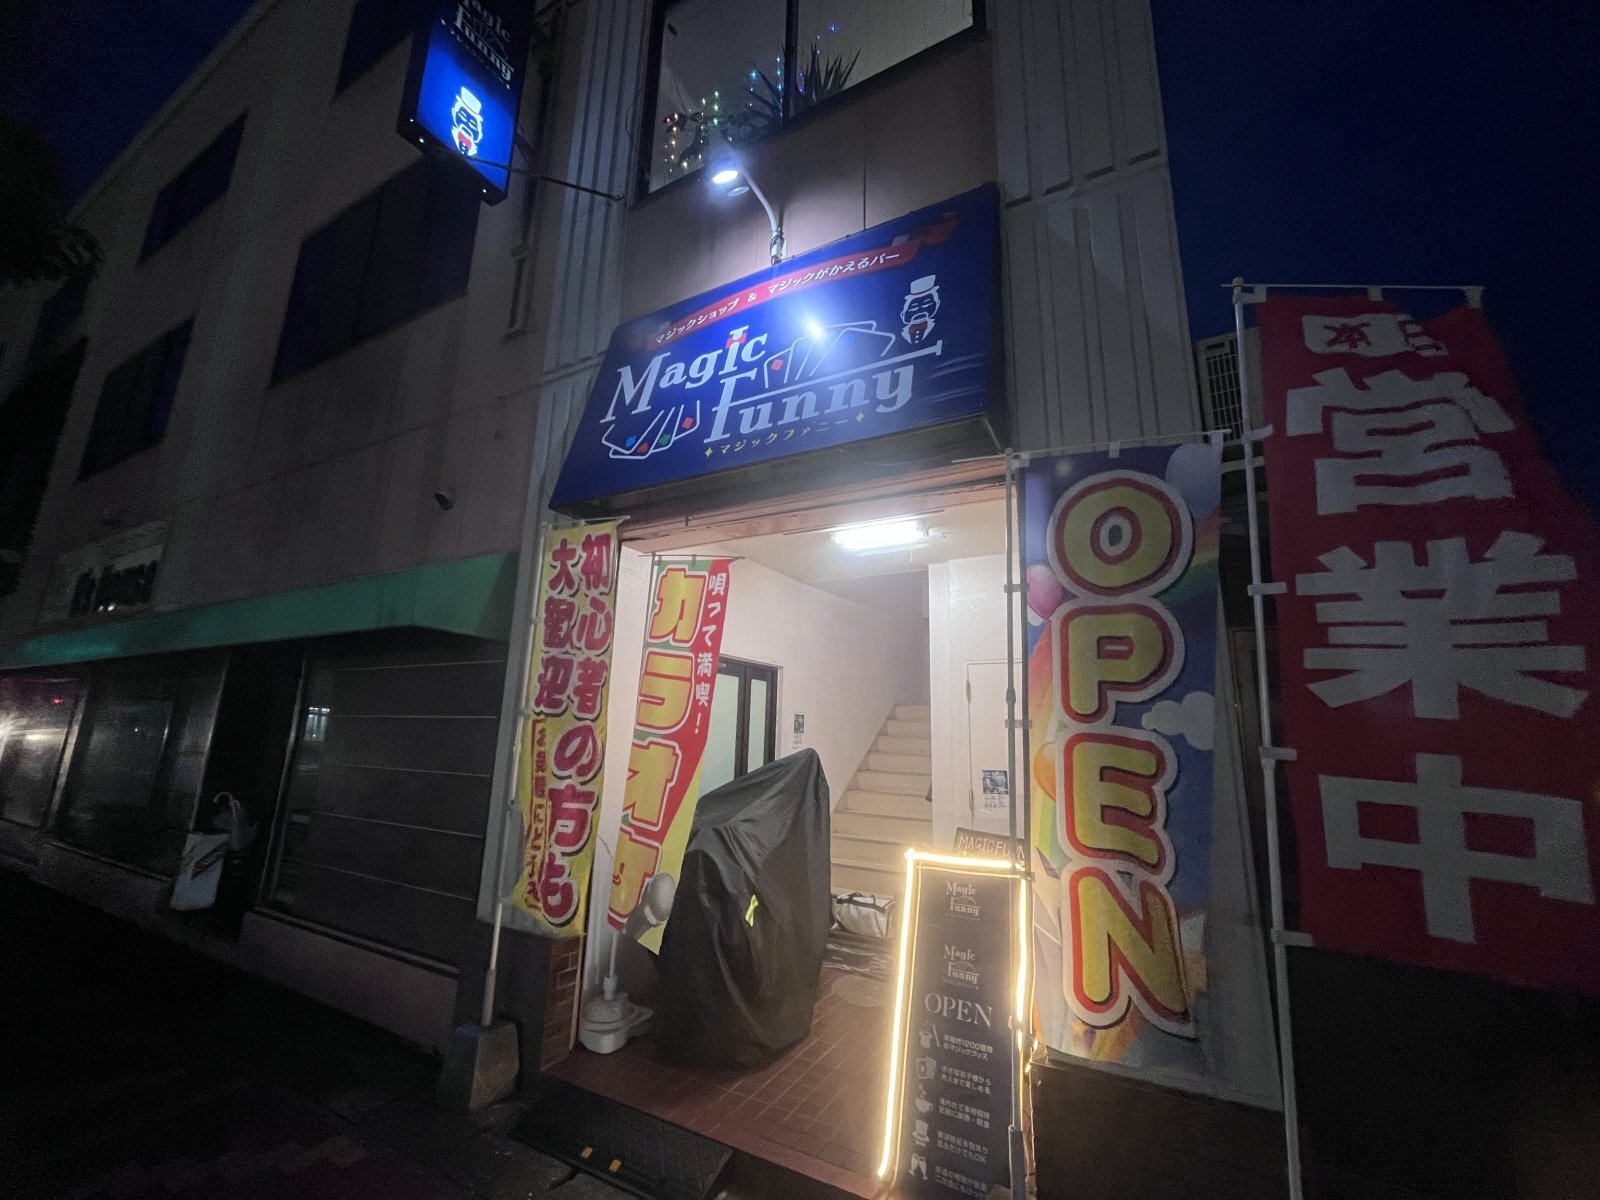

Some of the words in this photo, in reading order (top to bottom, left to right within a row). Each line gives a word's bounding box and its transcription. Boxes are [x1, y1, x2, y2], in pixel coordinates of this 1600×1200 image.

[454, 2, 515, 82] Funny
[657, 298, 739, 344] マジックショップ
[747, 293, 758, 303] &
[768, 253, 900, 294] マジックがかえるバー
[600, 325, 769, 424] Magic
[704, 340, 943, 443] Funny
[720, 419, 849, 454] マジックファニー
[535, 537, 578, 711] 大歓迎
[1287, 365, 1596, 946] 営業中
[1048, 470, 1194, 1034] OPEN
[946, 881, 977, 896] Magic
[950, 896, 980, 916] Funny
[944, 944, 975, 960] Magic
[948, 963, 979, 984] Funny
[925, 993, 993, 1028] OPEN
